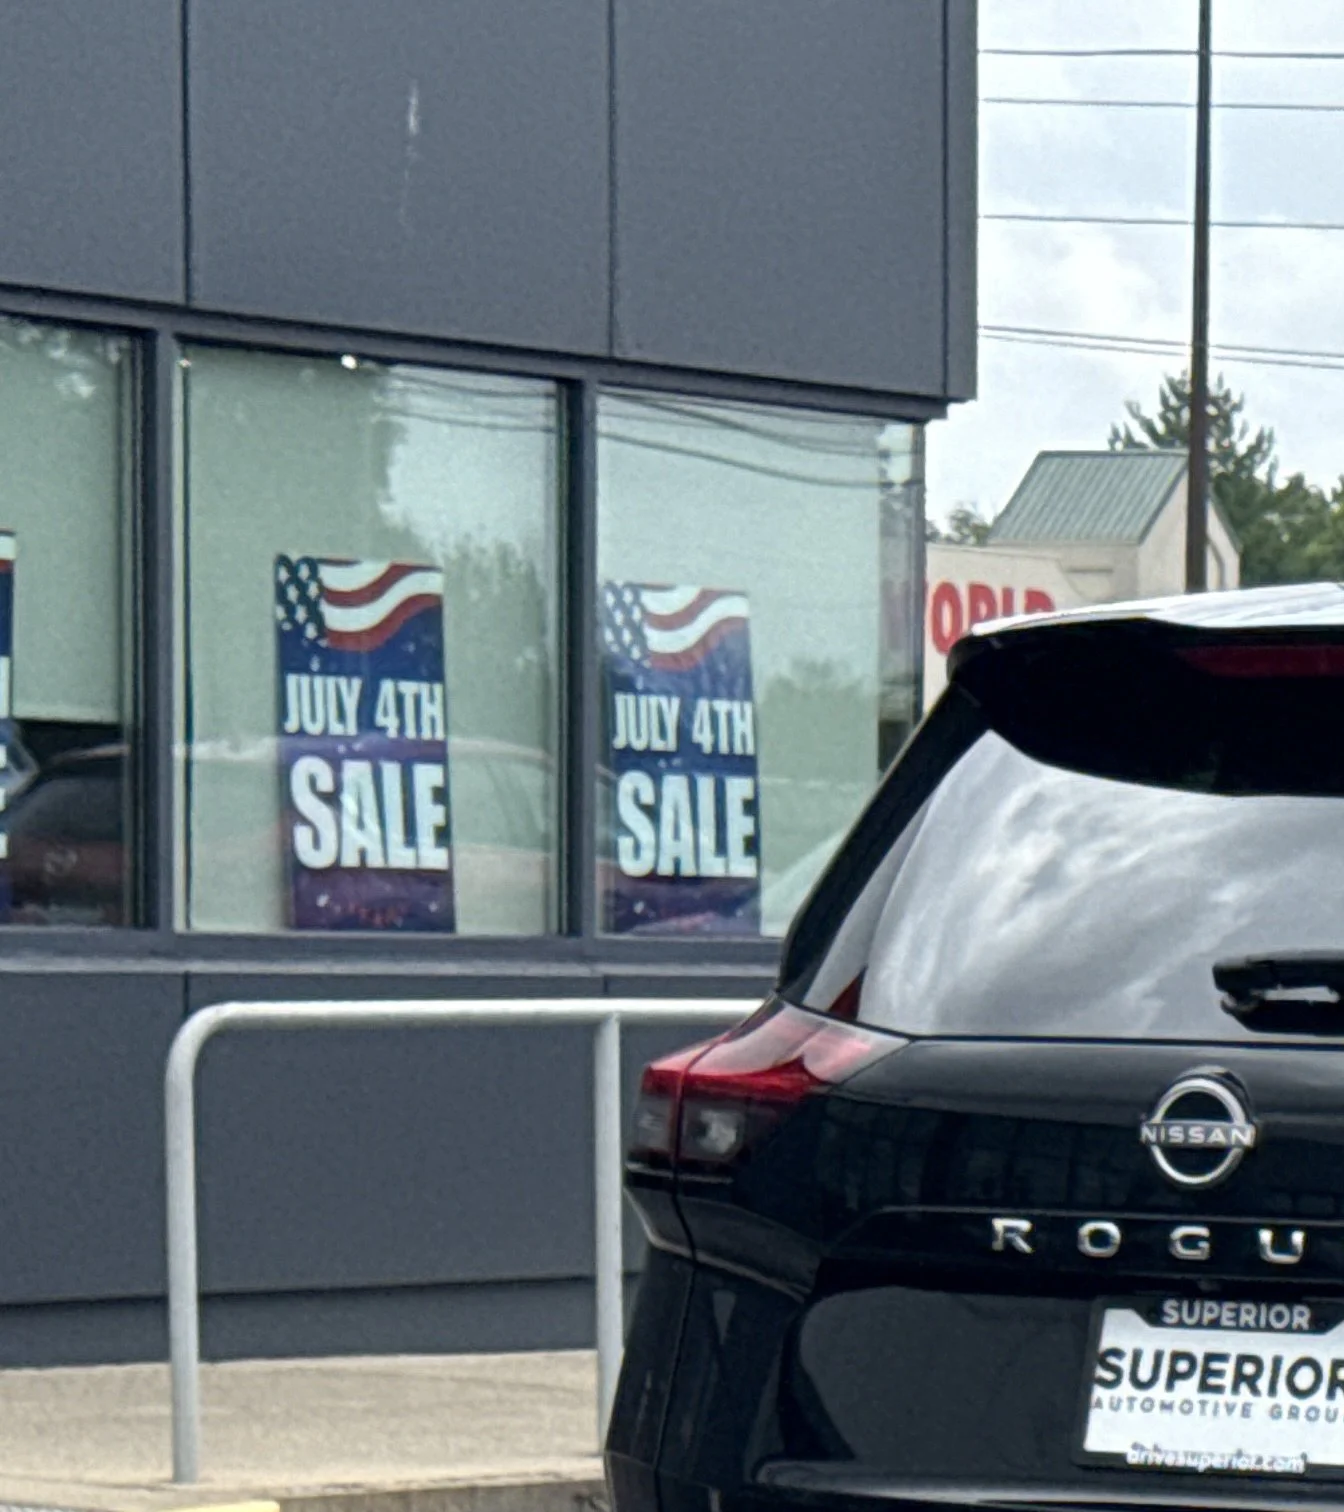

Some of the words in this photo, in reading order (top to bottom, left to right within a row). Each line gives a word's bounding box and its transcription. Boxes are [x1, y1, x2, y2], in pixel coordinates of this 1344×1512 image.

[284, 672, 362, 737] JULY
[374, 678, 446, 741] 4TH
[612, 691, 681, 752] JULY
[691, 698, 755, 755] 4TH
[289, 754, 449, 870] SALE
[617, 770, 758, 878] SALE
[1141, 1124, 1254, 1147] NISSAN
[1161, 1299, 1312, 1331] SUPERIOR
[1092, 1395, 1254, 1419] AUTOMOTIVE
